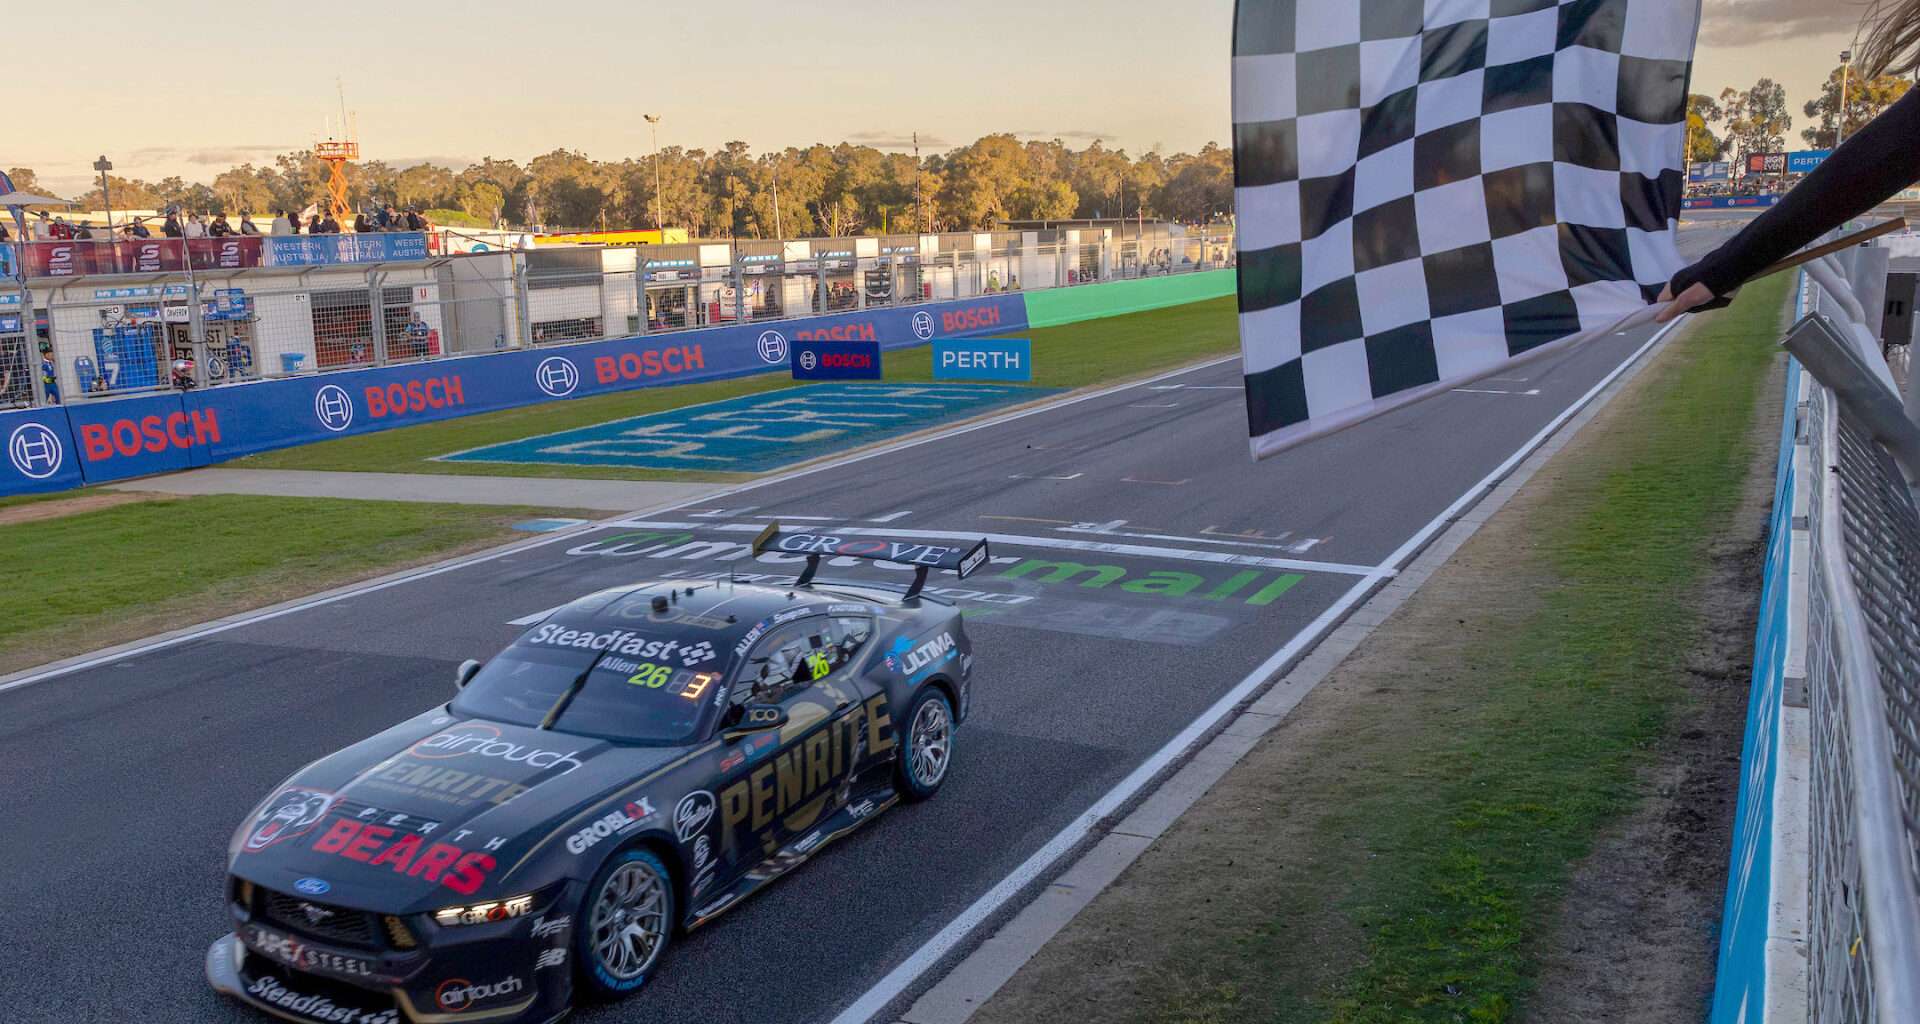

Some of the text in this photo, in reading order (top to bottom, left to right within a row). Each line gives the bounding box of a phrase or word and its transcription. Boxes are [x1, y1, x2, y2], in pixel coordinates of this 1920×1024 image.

[272, 252, 326, 262] AUSTRALIA
[273, 242, 321, 251] WESTERN
[334, 251, 386, 260] AUSTRALIA
[337, 240, 382, 249] WESTERN
[392, 248, 426, 257] AUSTRA
[393, 238, 424, 247] WESTE
[942, 306, 1001, 332] BOSCH
[178, 329, 221, 343] BLST
[594, 344, 705, 384] BOSCH
[822, 353, 871, 368] BOSCH
[942, 351, 1020, 369] PERTH
[365, 375, 465, 418] BOSCH
[80, 408, 222, 462] BOSCH
[536, 385, 1008, 461] PERTH
[778, 533, 949, 565] GROVE
[530, 624, 680, 661] Steadfast
[734, 627, 761, 657] ALLEN
[902, 631, 956, 676] ULTIMA
[596, 656, 673, 688] Allen 26
[808, 652, 830, 680] 26
[681, 674, 712, 699] 3
[749, 708, 779, 722] 100
[421, 733, 584, 776] airtouch
[375, 761, 531, 805] ENRITE
[720, 693, 895, 855] PENRITE
[566, 796, 657, 855] GROBLOX
[312, 819, 497, 895] BEARS
[461, 902, 533, 925] GROVE
[306, 950, 372, 976] STEEL
[248, 976, 361, 1023] Steadfast
[440, 975, 522, 1006] airtouch
